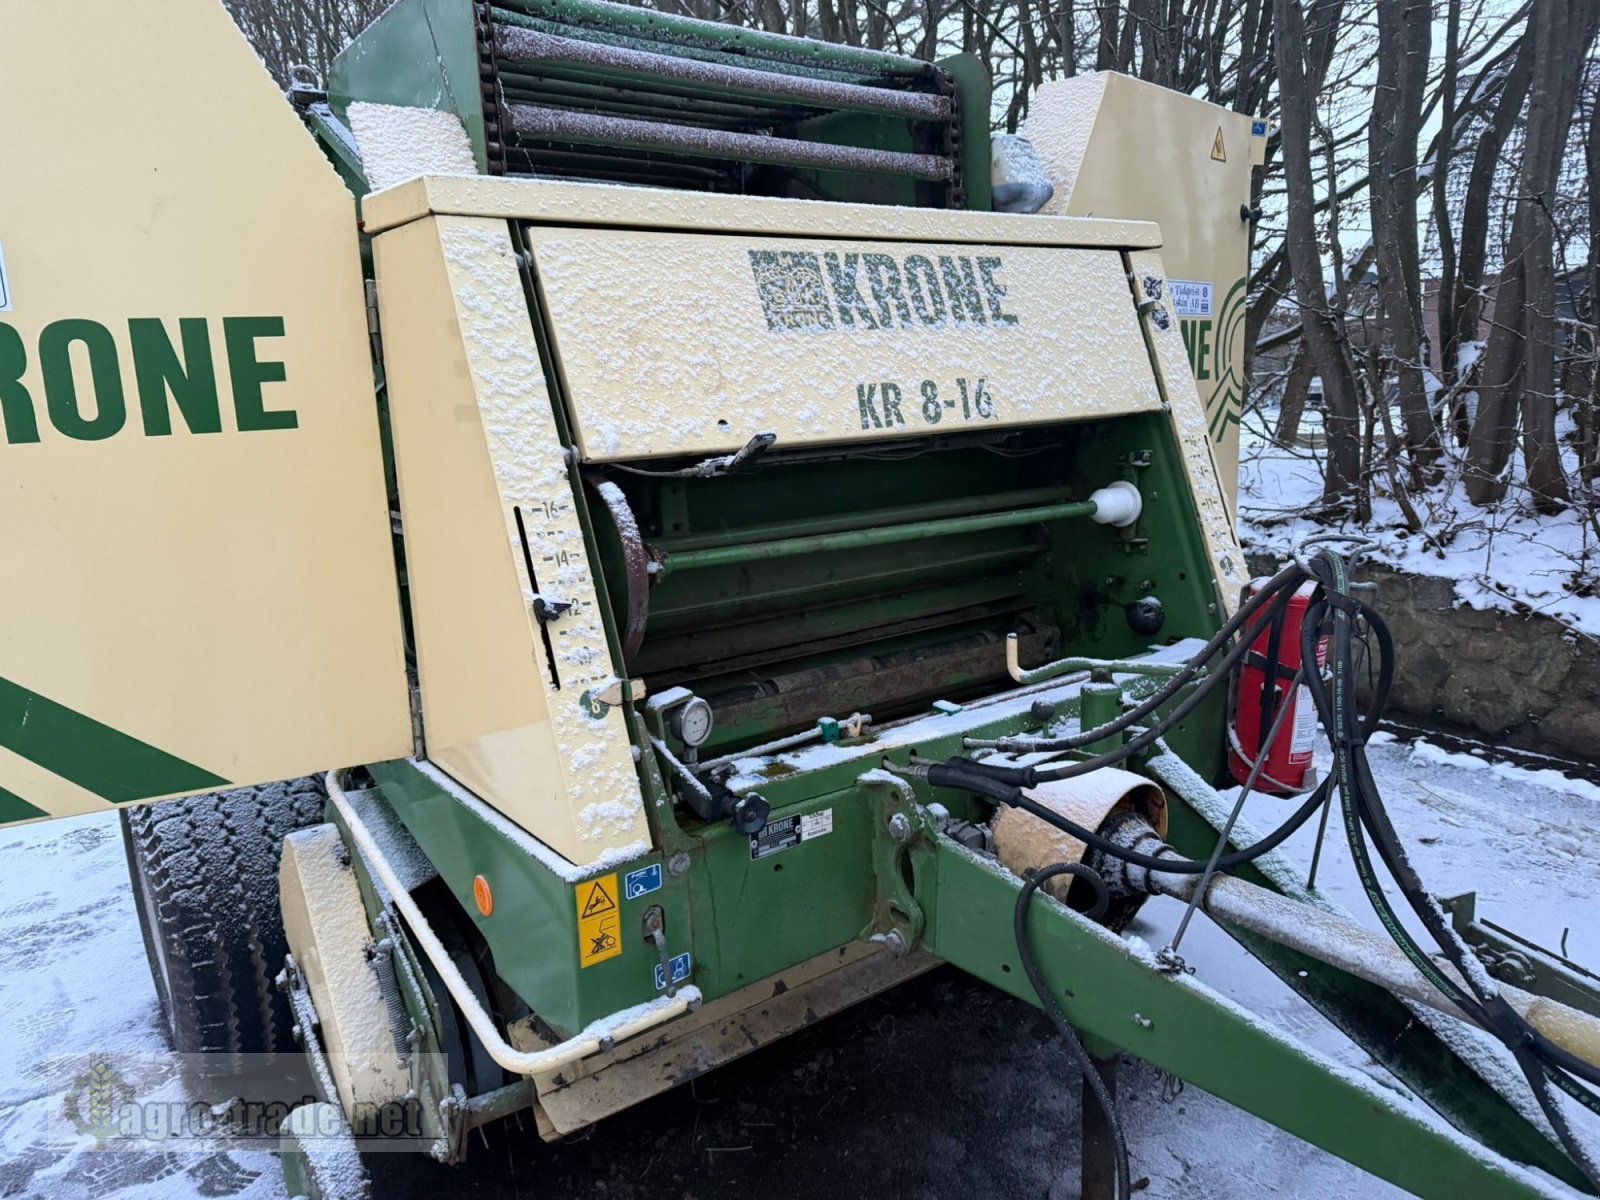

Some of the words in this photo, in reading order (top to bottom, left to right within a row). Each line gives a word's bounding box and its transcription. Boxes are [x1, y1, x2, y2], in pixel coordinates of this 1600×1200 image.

[824, 251, 1019, 330] KRONE
[856, 382, 906, 430] KR
[920, 376, 996, 425] 8-16
